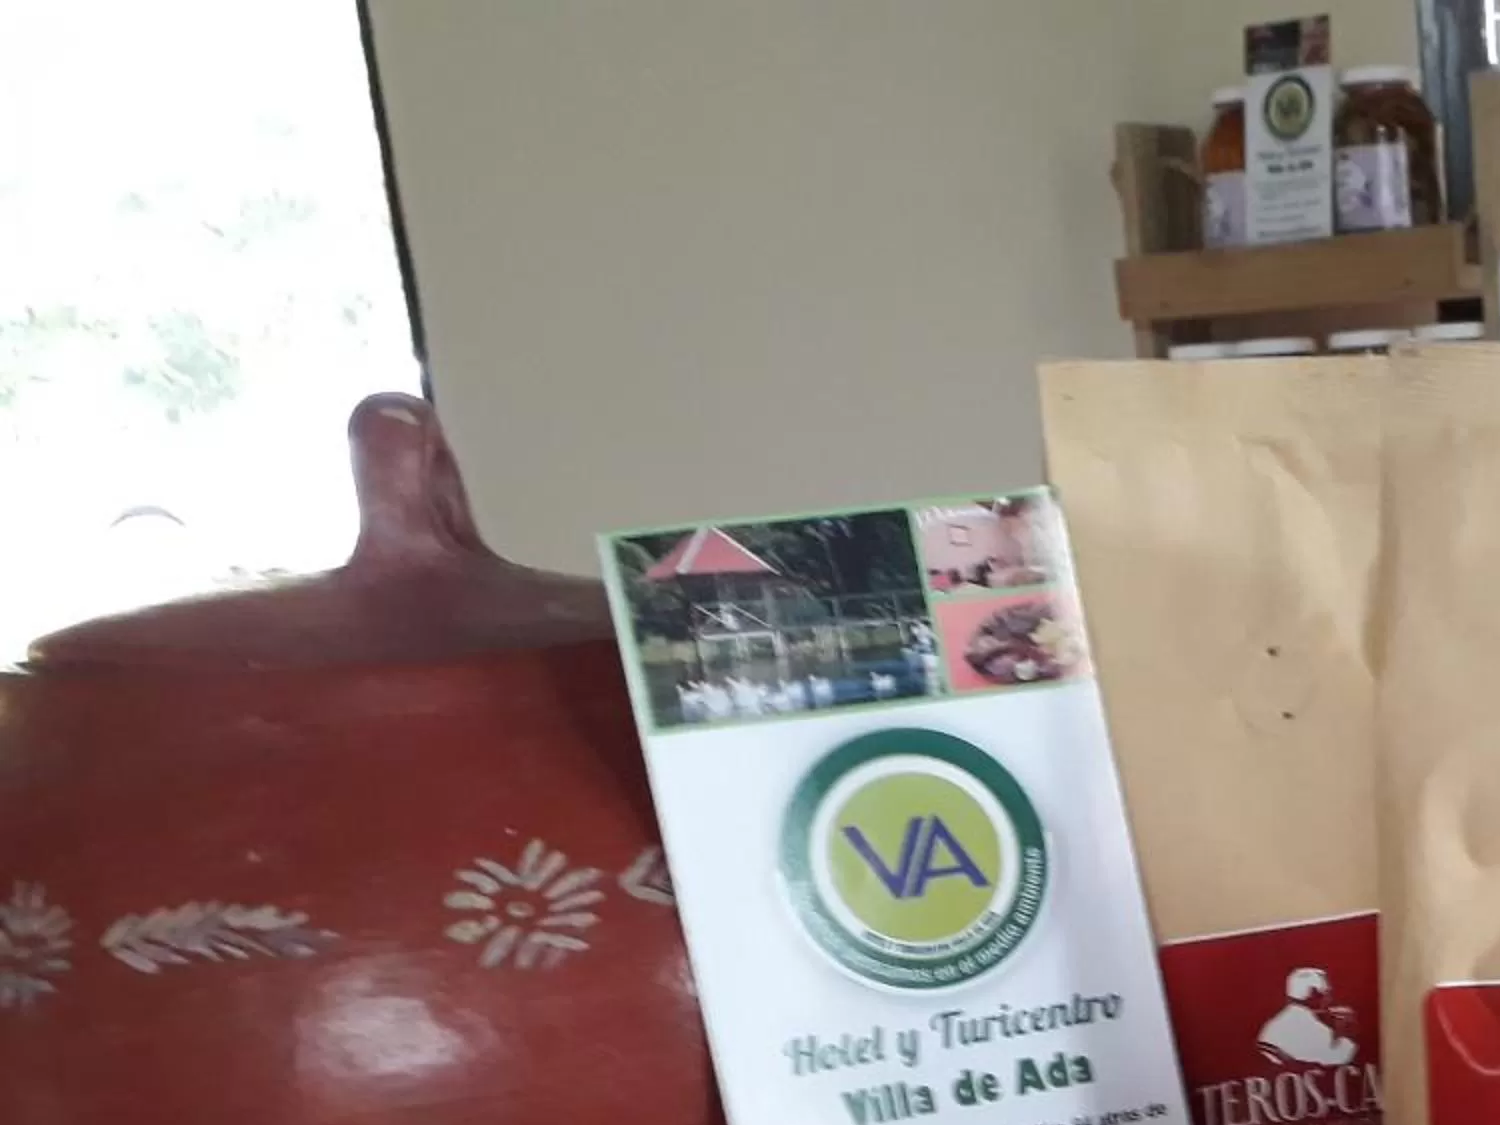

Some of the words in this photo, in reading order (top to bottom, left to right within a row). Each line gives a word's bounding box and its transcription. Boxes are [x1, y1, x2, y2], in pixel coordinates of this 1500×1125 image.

[842, 816, 990, 899] VA
[784, 1026, 887, 1075] Hotel
[895, 1028, 922, 1069] y
[927, 991, 1125, 1050] Turicentro
[950, 1067, 1002, 1107] de
[1013, 1051, 1098, 1096] Ada
